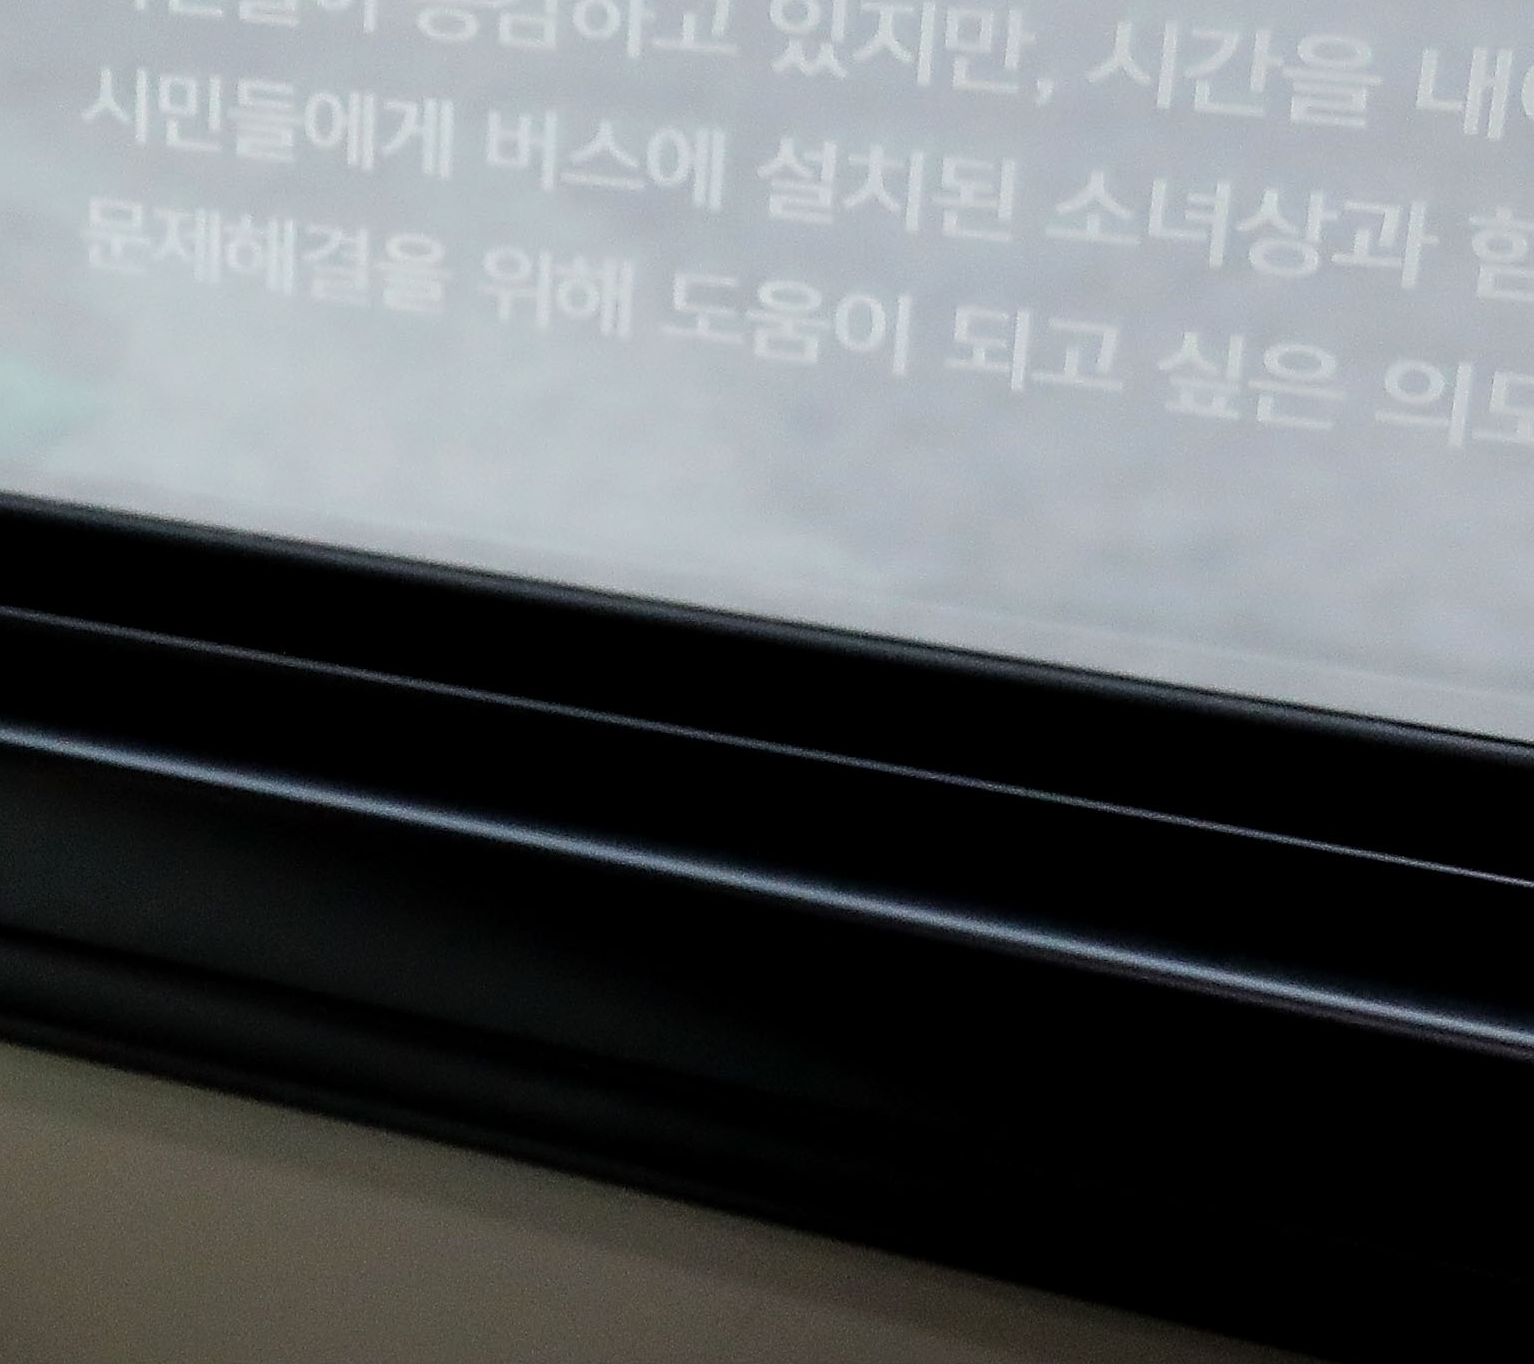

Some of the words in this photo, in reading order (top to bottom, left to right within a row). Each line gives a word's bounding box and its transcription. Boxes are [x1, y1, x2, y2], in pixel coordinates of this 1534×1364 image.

[81, 66, 456, 181] 시민들에게
[486, 109, 727, 214] 버스에
[756, 137, 1018, 244] 설치된
[1044, 170, 1440, 291] 소녀상과
[1084, 19, 1384, 130] 시간을
[1416, 46, 1534, 141] 내
[80, 195, 454, 318] 문제해결을
[478, 242, 637, 339] 위해
[659, 269, 914, 377] 도움이
[945, 302, 1125, 393] 되고
[1157, 331, 1347, 432] 싶은
